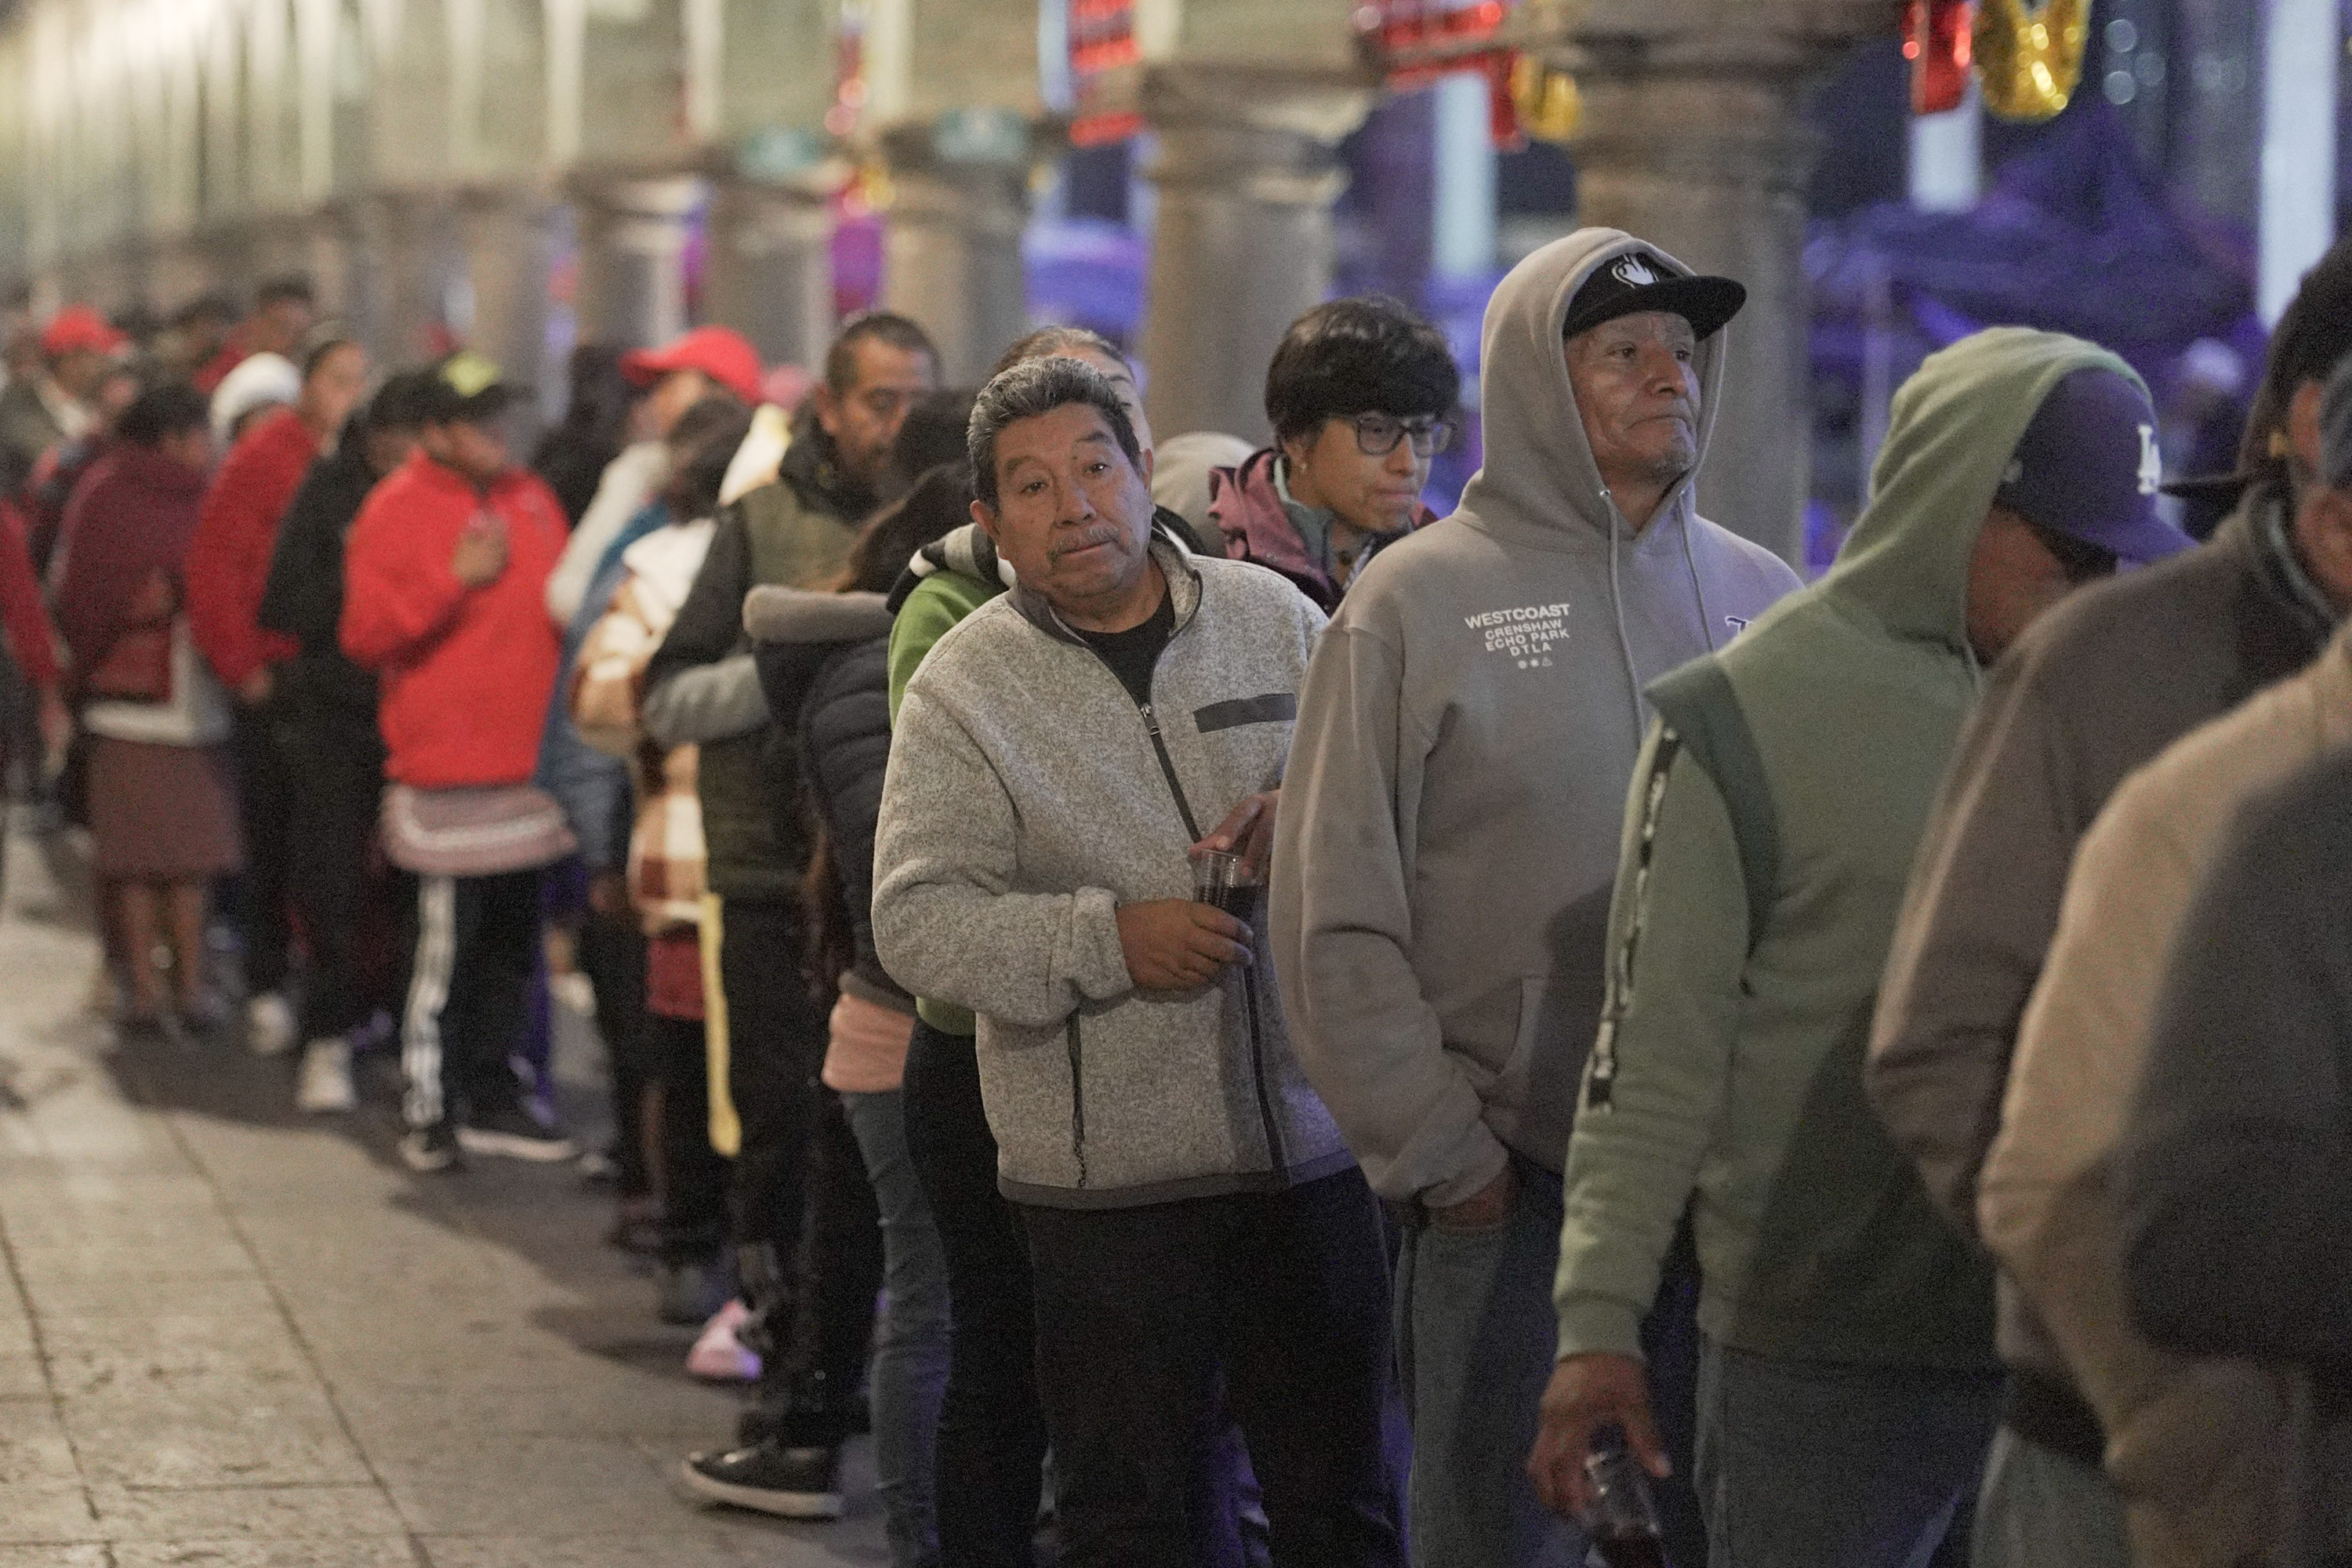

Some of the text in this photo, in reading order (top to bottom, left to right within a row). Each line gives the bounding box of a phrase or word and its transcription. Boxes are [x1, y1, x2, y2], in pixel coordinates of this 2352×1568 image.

[2138, 425, 2161, 493] LA
[1465, 604, 1570, 629] WESTCOAST
[1485, 619, 1562, 640] CRENSHAW
[1485, 629, 1570, 652] ECHO PARK
[1510, 642, 1552, 656] DTLA
